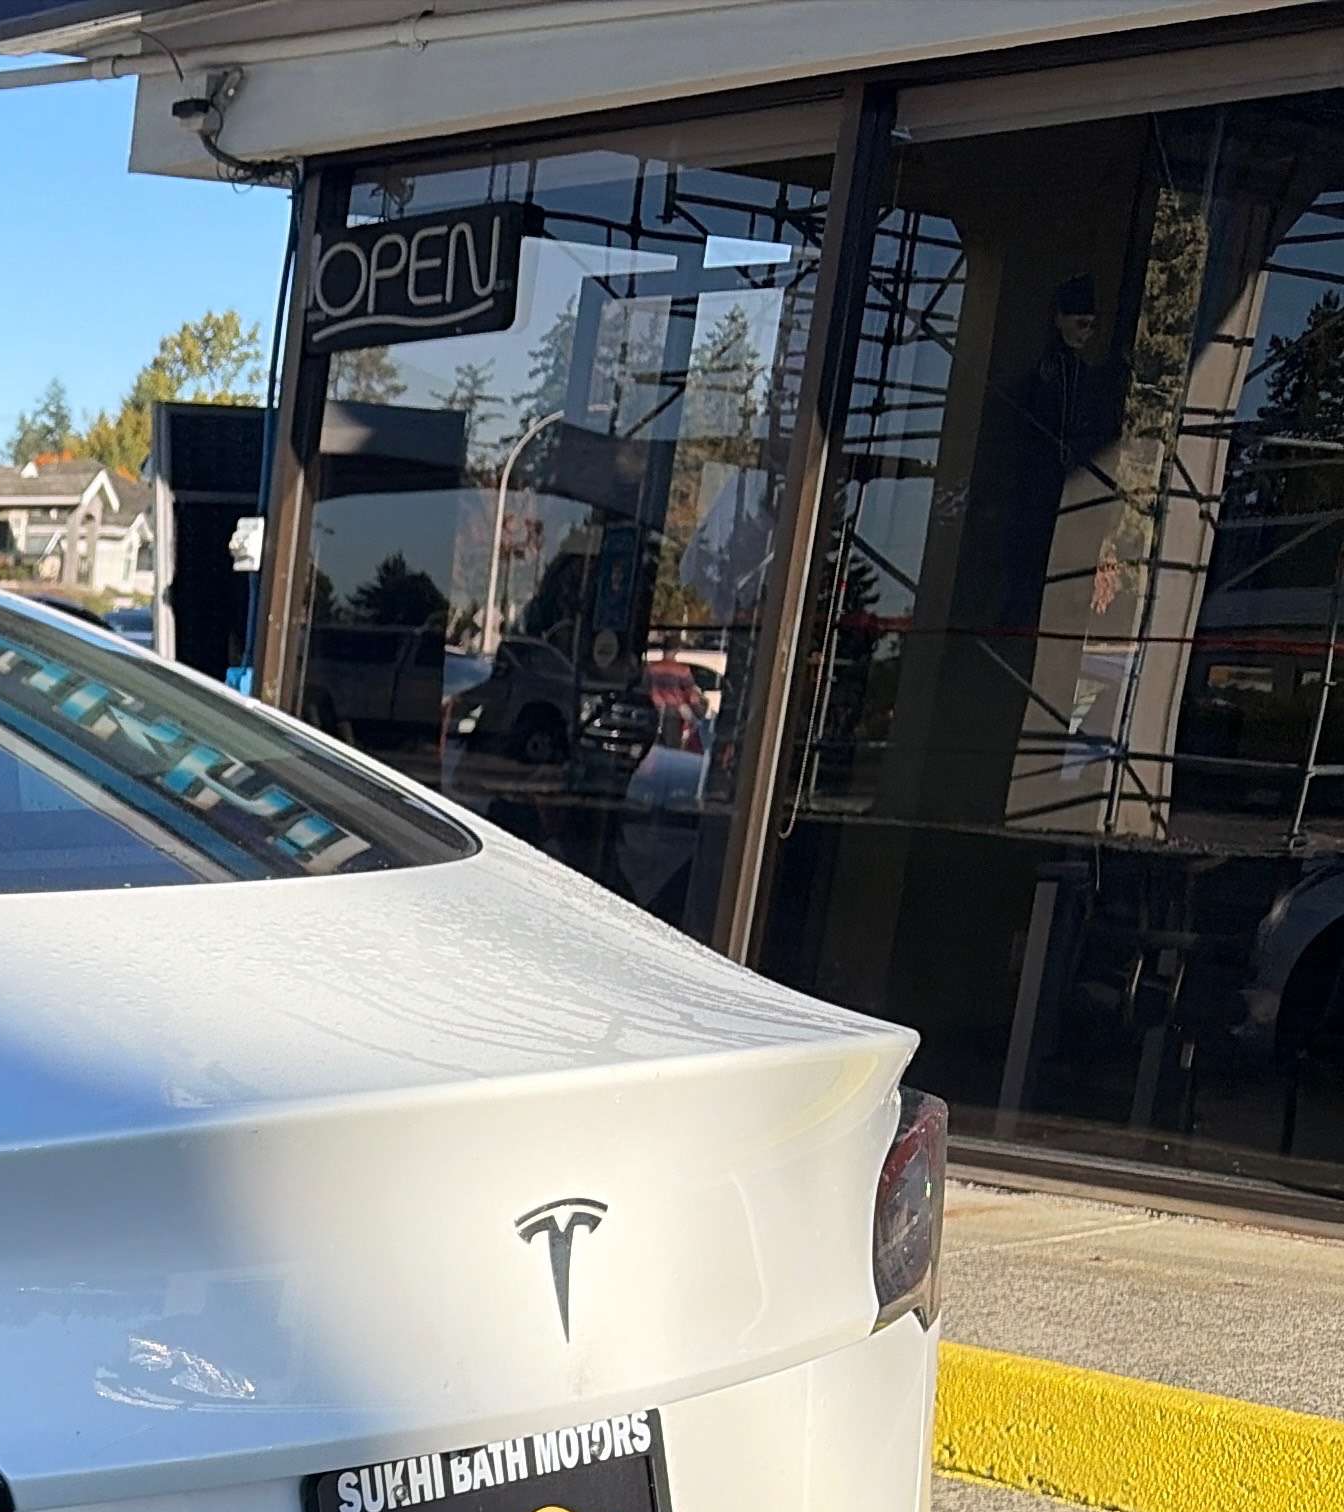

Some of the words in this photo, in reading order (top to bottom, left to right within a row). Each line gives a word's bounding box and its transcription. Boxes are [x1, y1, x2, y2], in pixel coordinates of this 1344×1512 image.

[315, 215, 501, 317] OPEN
[451, 1440, 529, 1496] BATH
[532, 1410, 652, 1476] MOTORS
